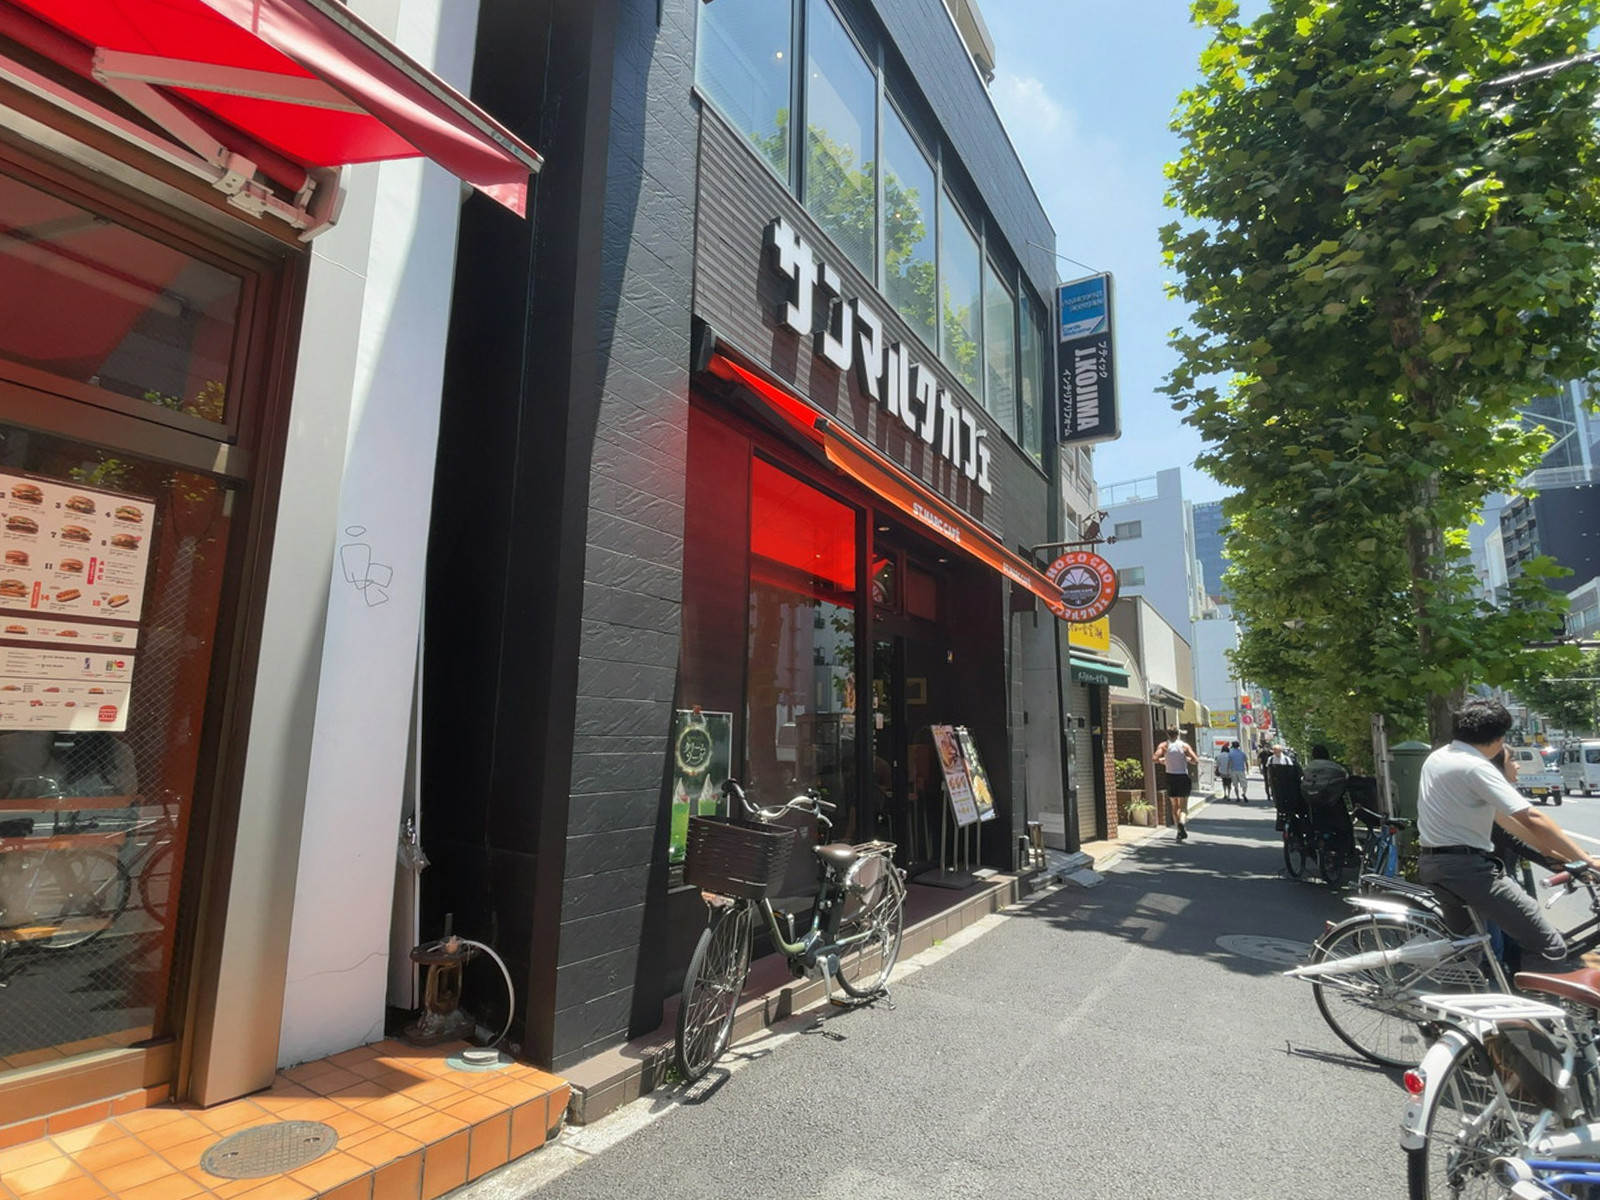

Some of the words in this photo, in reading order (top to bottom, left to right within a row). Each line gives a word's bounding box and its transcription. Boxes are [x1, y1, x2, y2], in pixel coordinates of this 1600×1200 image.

[768, 216, 992, 496] サンマルクカフェ
[1075, 347, 1099, 431] J.KOJIMA
